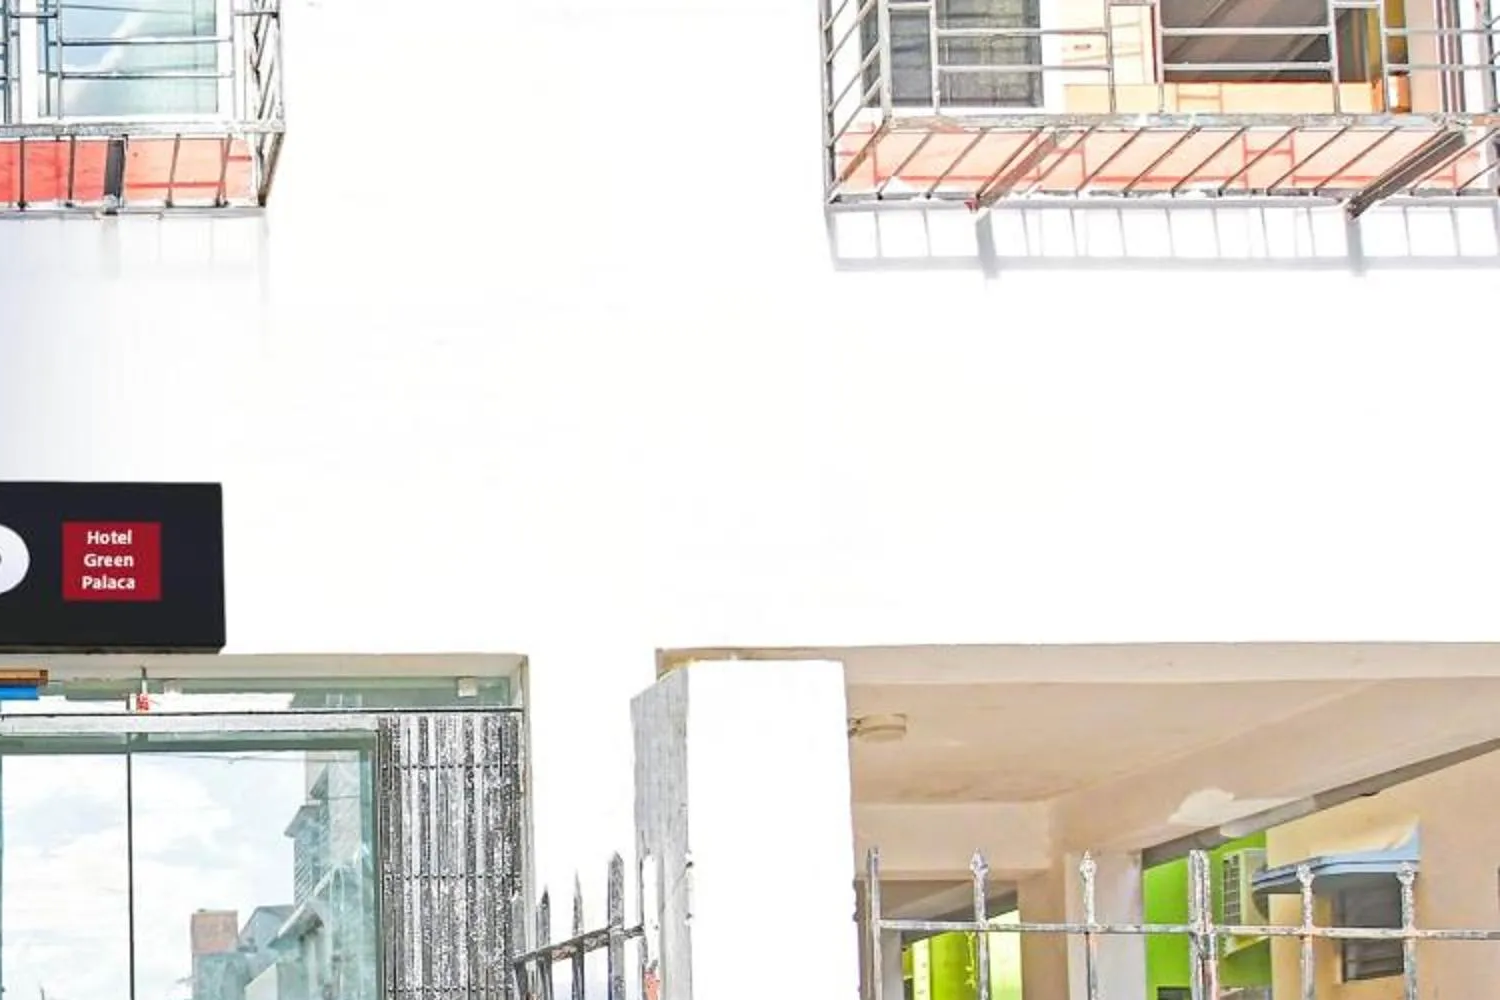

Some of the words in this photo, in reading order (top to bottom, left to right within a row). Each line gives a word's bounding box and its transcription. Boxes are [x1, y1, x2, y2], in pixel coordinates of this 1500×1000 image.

[86, 529, 133, 545] Hotel
[83, 553, 135, 568] Green
[81, 574, 136, 590] Palaca
